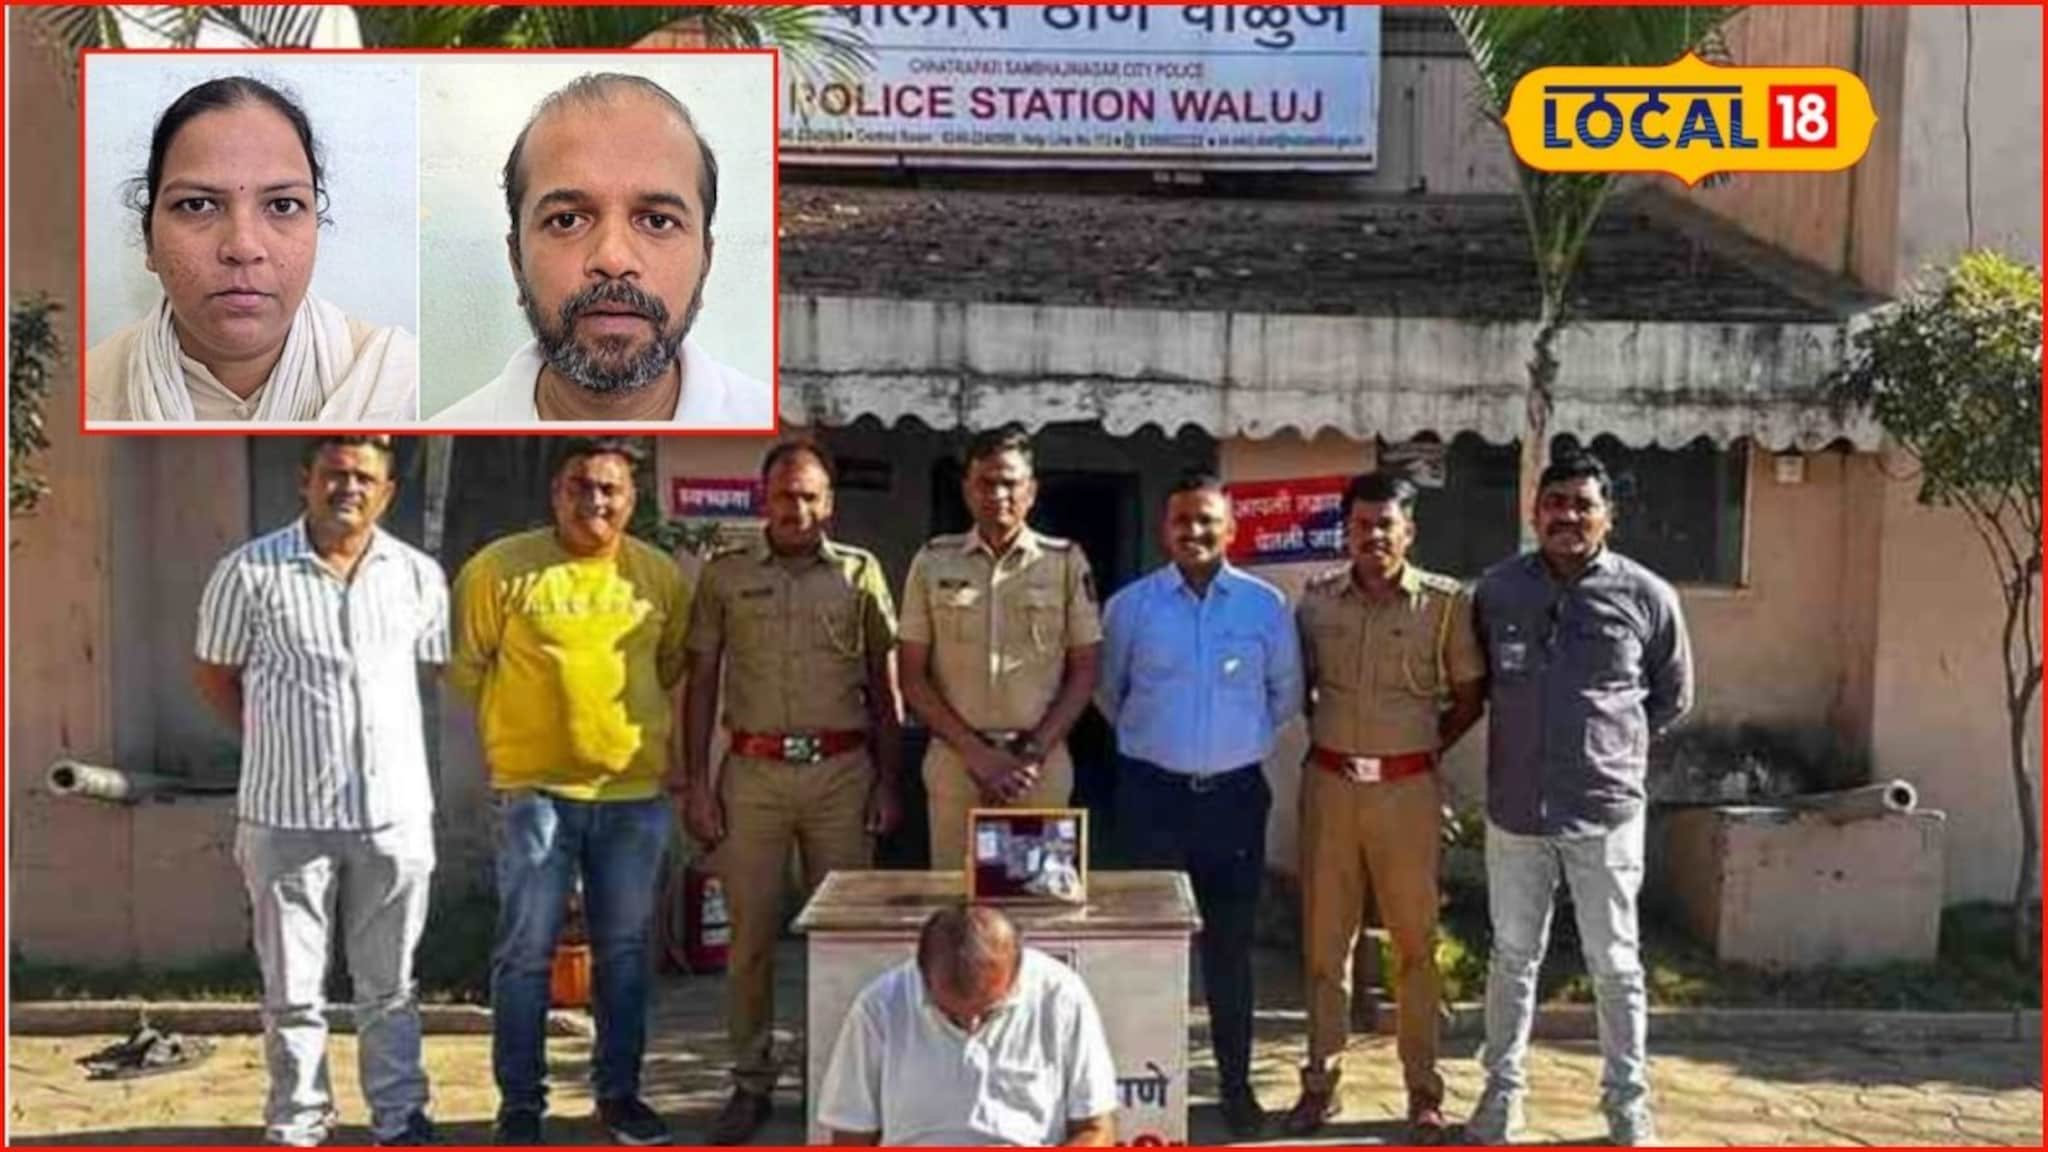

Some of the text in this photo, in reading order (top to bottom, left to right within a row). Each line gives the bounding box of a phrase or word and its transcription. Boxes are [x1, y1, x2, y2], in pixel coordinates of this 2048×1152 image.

[1156, 62, 1204, 78] POLICE
[789, 83, 1323, 123] POLICE STATION WALUJ
[1115, 1061, 1169, 1108] ाणे
